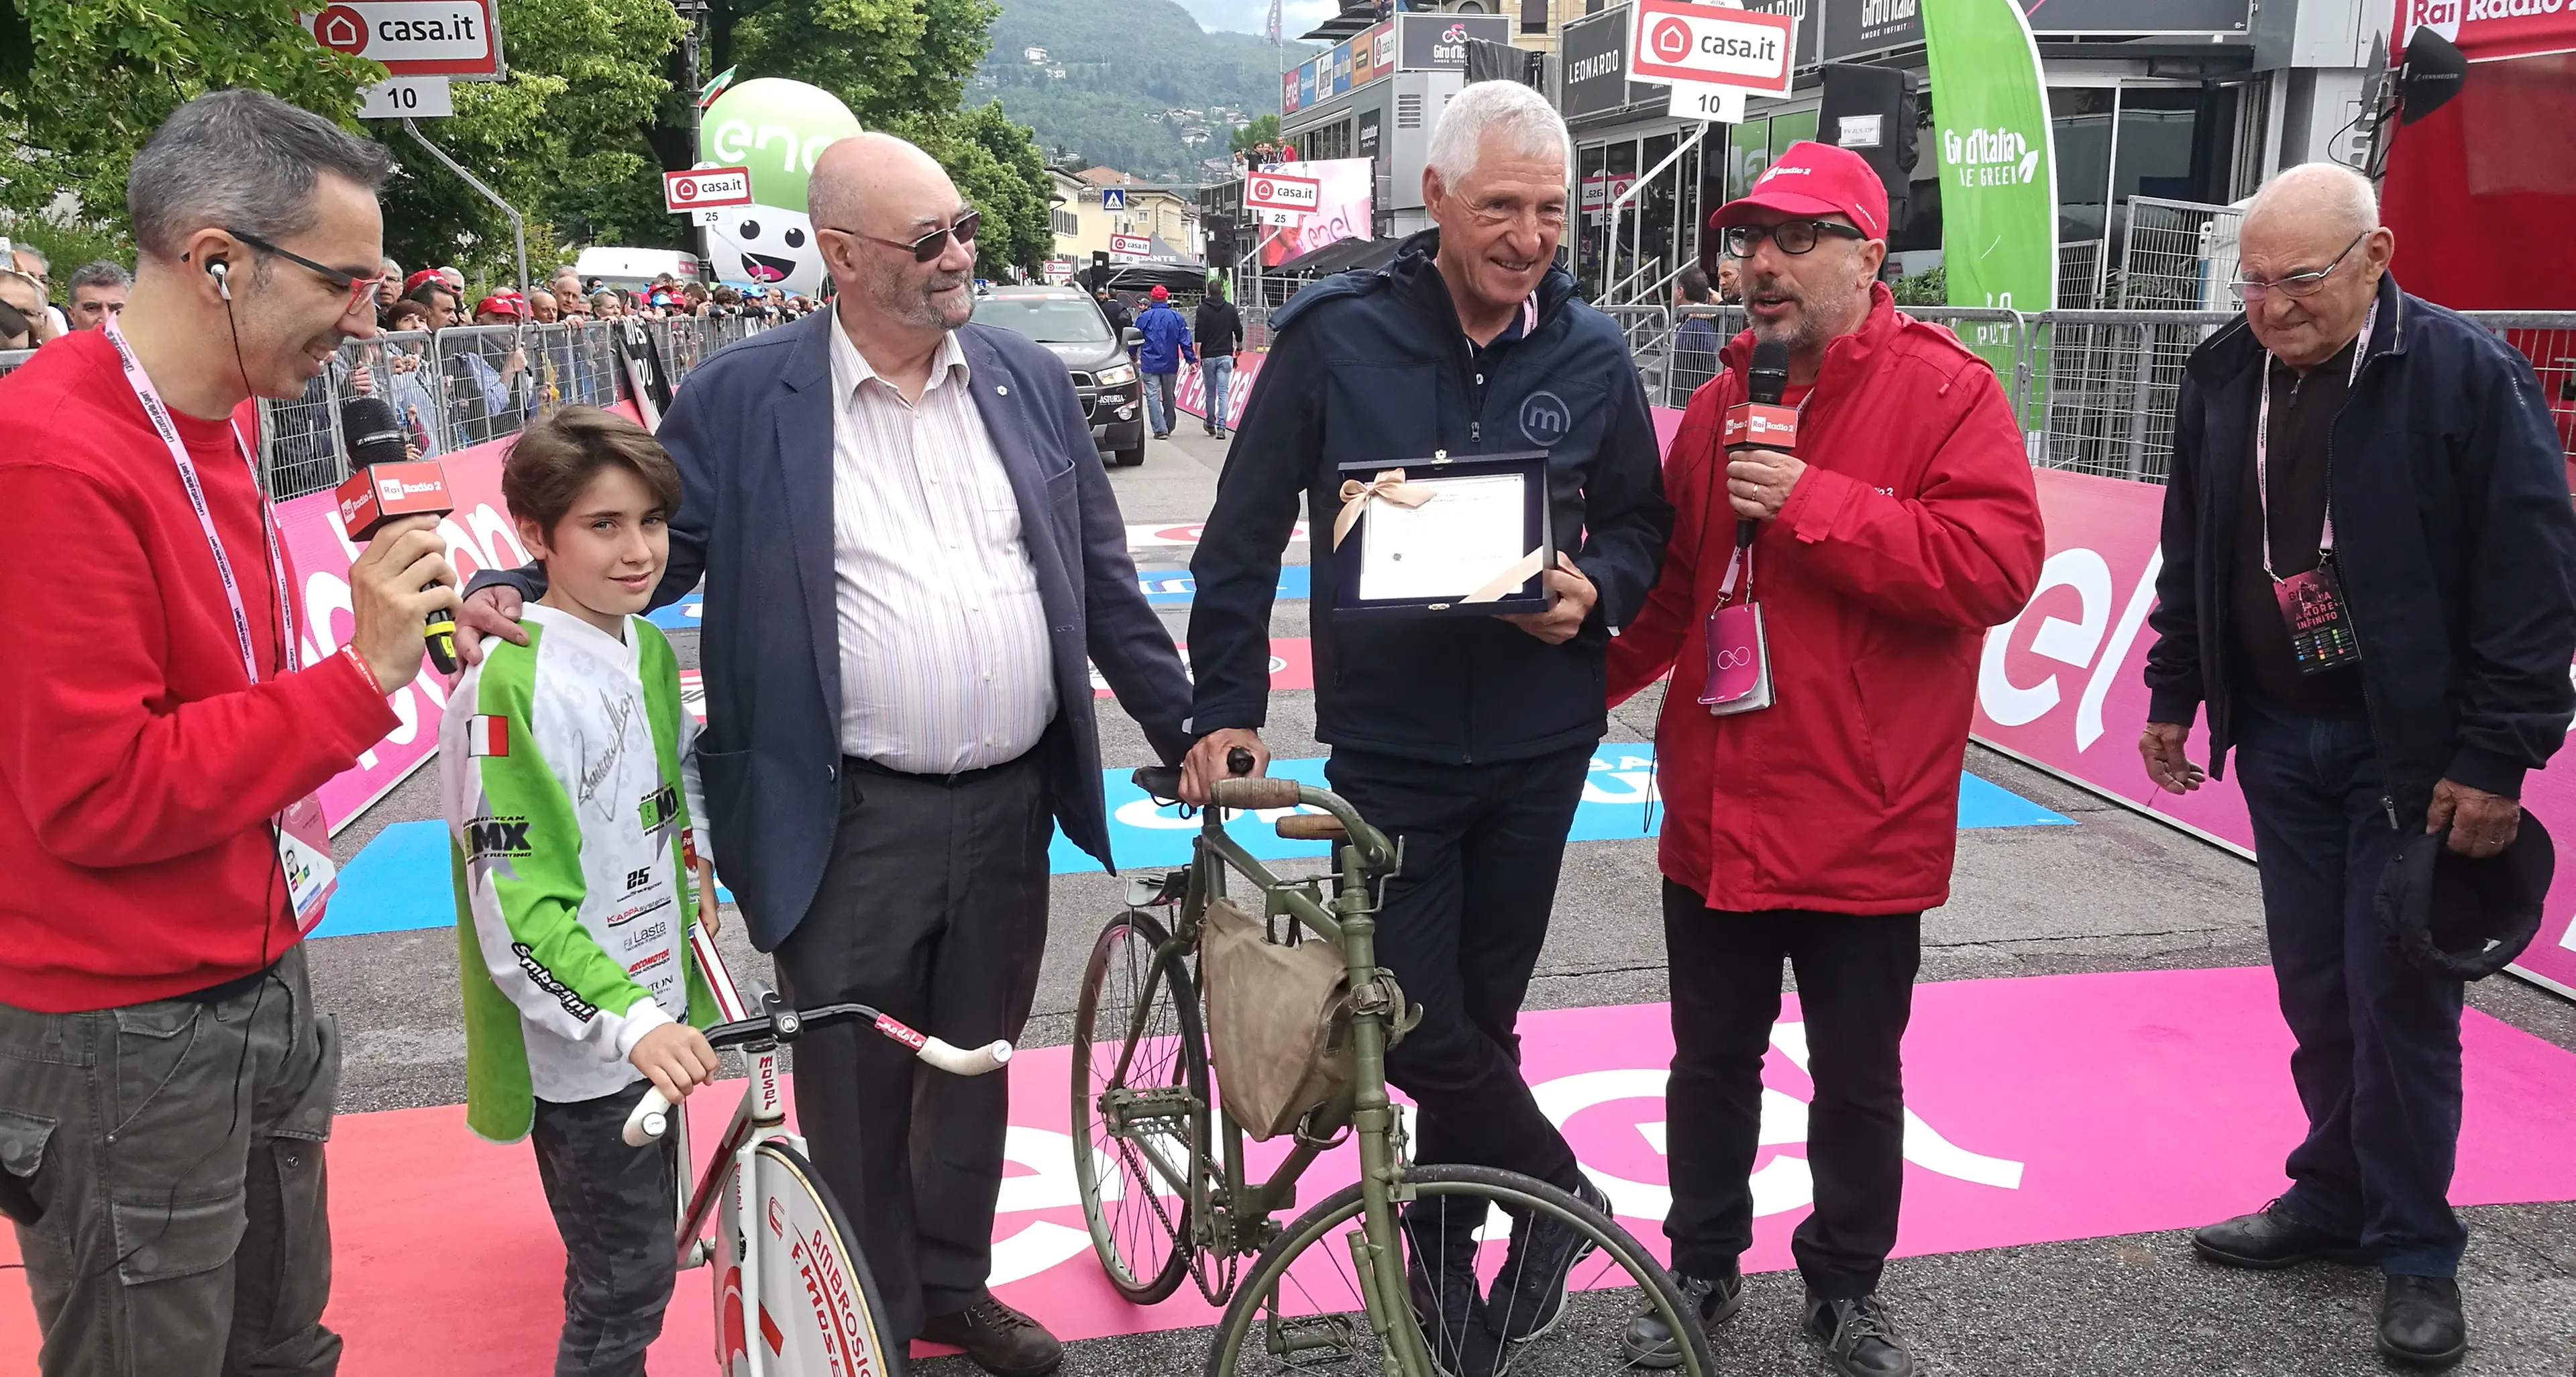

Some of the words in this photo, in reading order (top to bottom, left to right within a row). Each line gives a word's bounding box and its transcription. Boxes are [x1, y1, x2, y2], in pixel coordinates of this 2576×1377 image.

[378, 13, 476, 42] casa.it
[1434, 44, 1450, 58] Giro
[1701, 35, 1776, 61] casa.it
[1568, 49, 1619, 85] LEONARDO
[387, 88, 417, 109] 10
[1285, 74, 1298, 107] enel
[1699, 94, 1720, 113] 10
[702, 178, 742, 193] casa.it
[1277, 187, 1313, 199] casa.it
[705, 212, 718, 221] 25
[1275, 214, 1286, 223] 25
[1308, 204, 1352, 248] enel
[1127, 242, 1148, 250] casa.it
[1529, 405, 1560, 433] m
[1766, 423, 1788, 431] Radio
[383, 484, 400, 495] Rai
[402, 484, 433, 493] Radio
[433, 481, 442, 491] 2
[1886, 488, 1894, 497] 2
[343, 505, 353, 517] Rai
[352, 495, 368, 511] Radio
[367, 490, 373, 499] 2
[2297, 611, 2338, 629] INFINITO
[627, 866, 651, 890] 25
[634, 921, 666, 943] Lasta
[759, 1055, 777, 1111] moser
